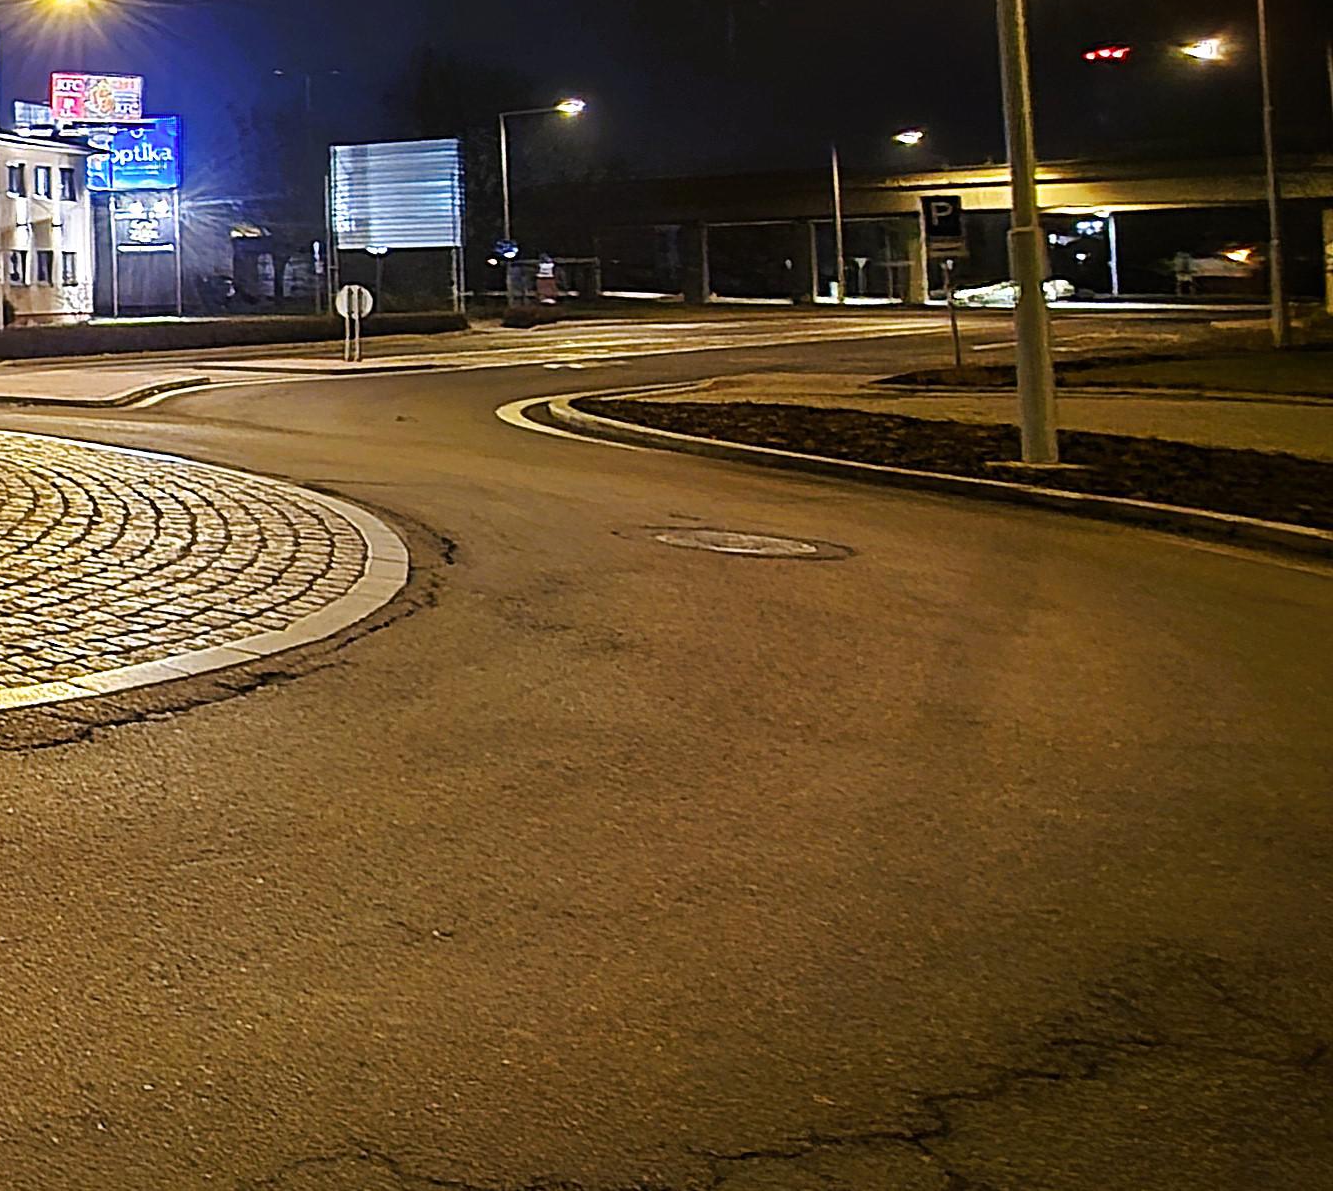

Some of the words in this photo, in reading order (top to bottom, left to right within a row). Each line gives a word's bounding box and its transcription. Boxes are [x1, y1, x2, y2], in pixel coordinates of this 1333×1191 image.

[55, 78, 84, 91] KFC
[114, 102, 139, 114] KFC
[110, 141, 174, 166] optika
[930, 201, 954, 227] P
